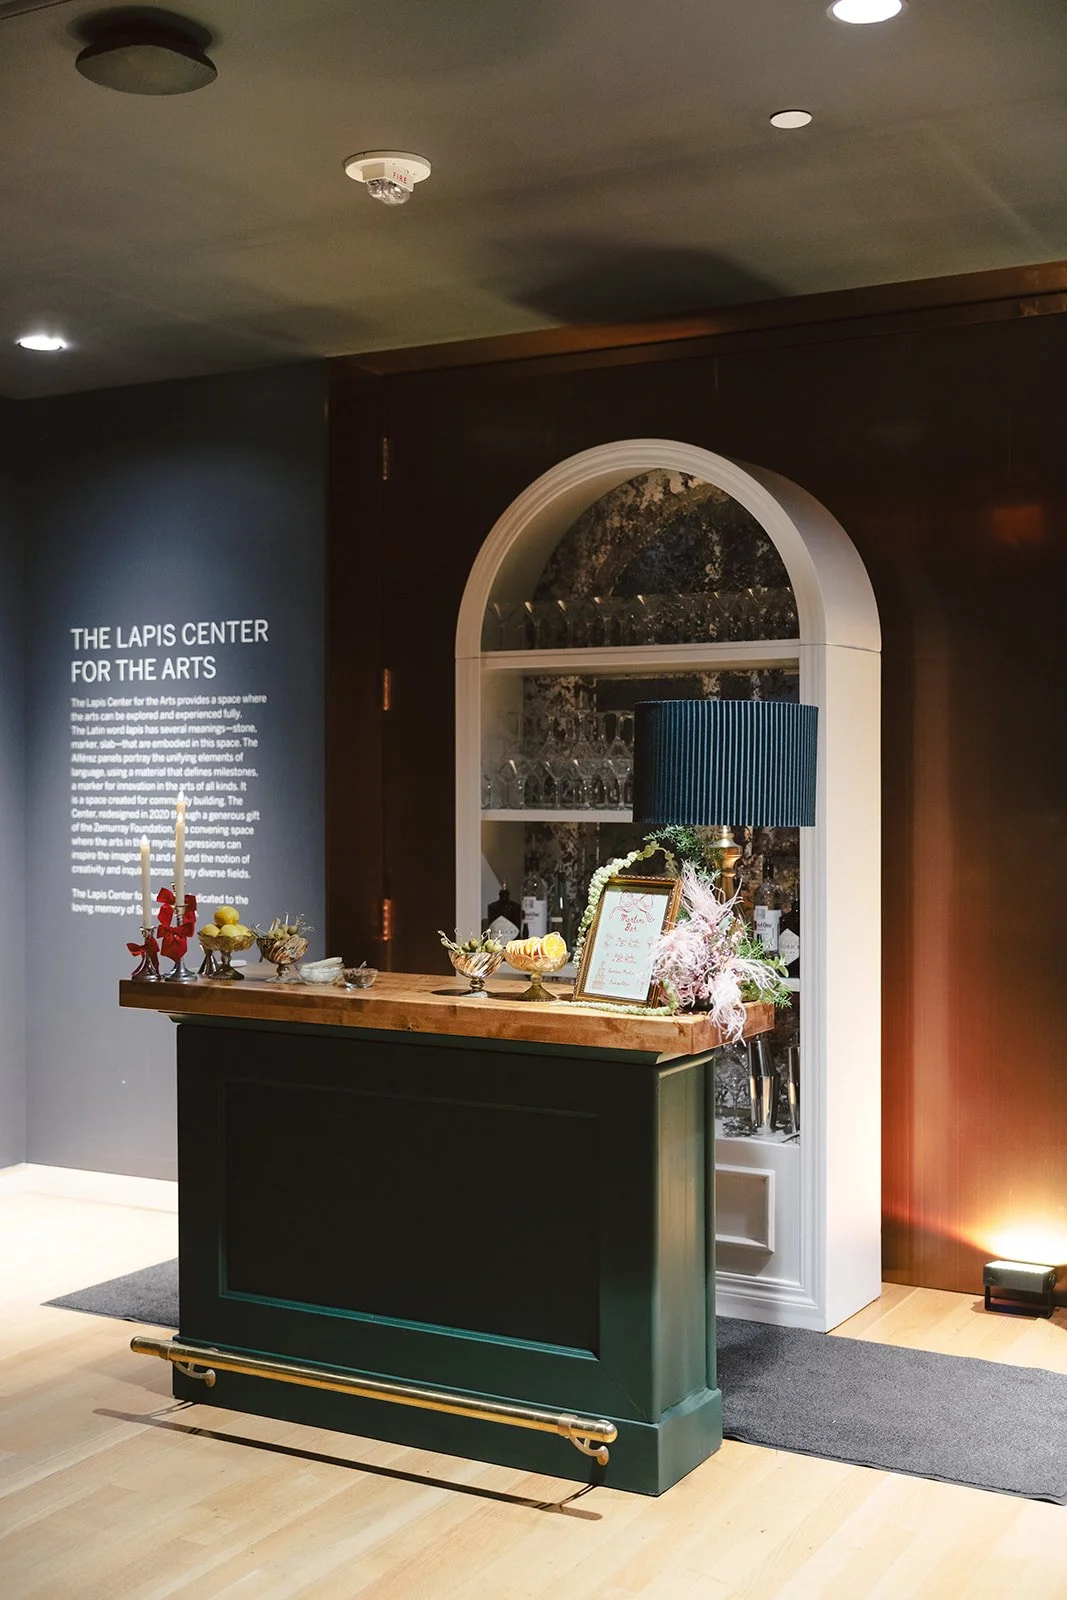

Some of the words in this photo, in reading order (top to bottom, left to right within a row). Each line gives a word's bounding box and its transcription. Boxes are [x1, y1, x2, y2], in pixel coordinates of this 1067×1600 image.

[392, 172, 408, 184] FIRE
[70, 626, 111, 650] THE
[116, 623, 177, 649] LAPIS
[181, 619, 268, 646] CENTER
[70, 660, 110, 683] FOR
[115, 658, 158, 681] THE
[161, 656, 216, 680] ARTS
[71, 698, 86, 708] The
[86, 698, 106, 709] Lapis
[108, 696, 132, 707] Center
[134, 696, 144, 706] for
[145, 696, 160, 706] the
[160, 696, 176, 705] Arts
[176, 695, 210, 706] provides
[218, 696, 241, 706] space
[242, 694, 268, 704] where
[71, 712, 84, 721] the
[84, 712, 100, 721] arts
[100, 713, 114, 721] can
[115, 712, 125, 720] be
[126, 710, 159, 722] explored
[160, 710, 174, 720] and
[175, 710, 222, 721] experienced
[71, 726, 86, 735] The
[86, 726, 106, 736] Latin
[106, 725, 126, 734] word
[126, 725, 144, 736] lapis
[144, 724, 160, 734] has
[160, 724, 188, 734] several
[152, 738, 190, 748] embodied
[192, 738, 200, 748] in
[200, 738, 215, 748] this
[242, 737, 259, 748] The
[98, 753, 122, 764] panels
[122, 754, 151, 764] portray
[152, 753, 166, 762] the
[166, 752, 198, 764] unifying
[198, 752, 234, 762] elements
[234, 752, 244, 762] of
[106, 768, 128, 779] using
[134, 768, 166, 777] material
[167, 767, 183, 776] that
[183, 766, 212, 777] defines
[78, 782, 104, 790] marker
[104, 780, 116, 790] for
[116, 781, 156, 790] innovation
[156, 781, 164, 790] in
[165, 781, 178, 791] the
[179, 782, 195, 791] arts
[196, 781, 204, 791] of
[205, 781, 216, 790] all
[240, 782, 248, 791] It
[72, 796, 78, 804] is
[84, 797, 108, 806] space
[108, 796, 136, 805] created
[137, 795, 148, 804] for
[228, 796, 244, 806] The
[98, 810, 140, 820] redesigned
[140, 810, 148, 819] in
[148, 809, 170, 820] 2020
[202, 812, 208, 820] a
[208, 812, 245, 822] generous
[246, 810, 260, 822] gift
[72, 822, 80, 832] of
[80, 822, 94, 832] the
[190, 825, 230, 836] convening
[230, 826, 254, 836] space
[72, 838, 94, 846] where
[94, 837, 108, 847] the
[108, 838, 124, 847] arts
[124, 838, 132, 847] in
[226, 841, 242, 849] can
[72, 851, 97, 861] inspire
[98, 850, 110, 861] the
[155, 852, 171, 862] and
[200, 853, 214, 863] the
[214, 854, 240, 864] notion
[241, 854, 250, 864] of
[72, 865, 106, 876] creativity
[106, 866, 121, 874] and
[198, 868, 226, 878] diverse
[72, 888, 86, 898] The
[87, 890, 107, 900] Lapis
[108, 890, 134, 900] Center
[134, 890, 142, 900] fo
[225, 895, 236, 904] to
[236, 895, 250, 905] the
[72, 903, 94, 915] loving
[94, 905, 126, 916] memory
[126, 904, 135, 914] of
[620, 914, 645, 924] Martini
